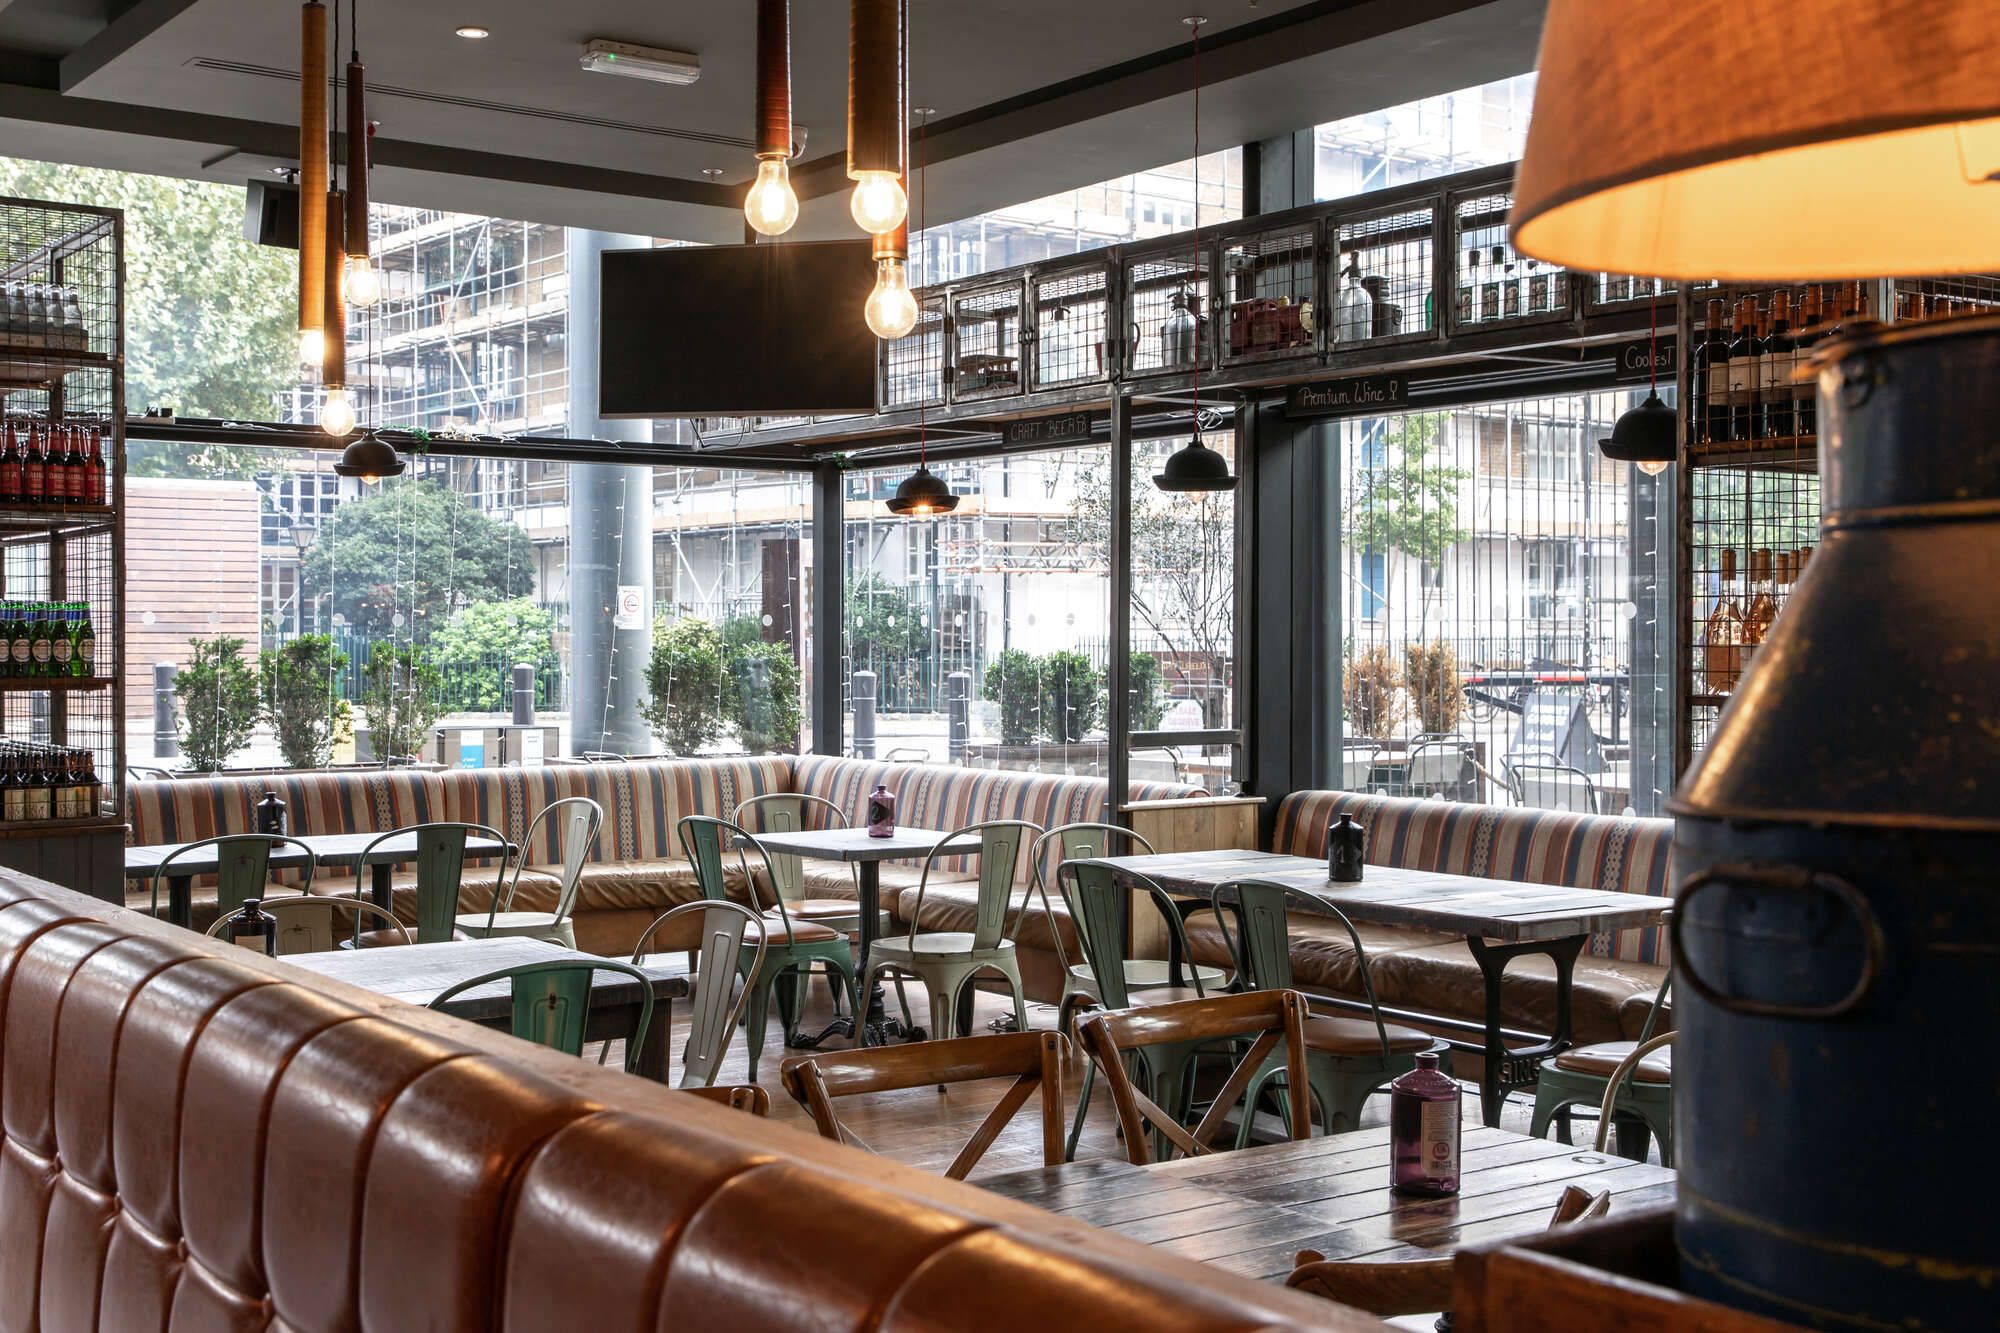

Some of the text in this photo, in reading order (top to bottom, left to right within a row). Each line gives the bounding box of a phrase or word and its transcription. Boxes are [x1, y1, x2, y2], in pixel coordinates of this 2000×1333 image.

[1298, 382, 1385, 407] Premium Wine
[1010, 422, 1043, 441] CRAFT
